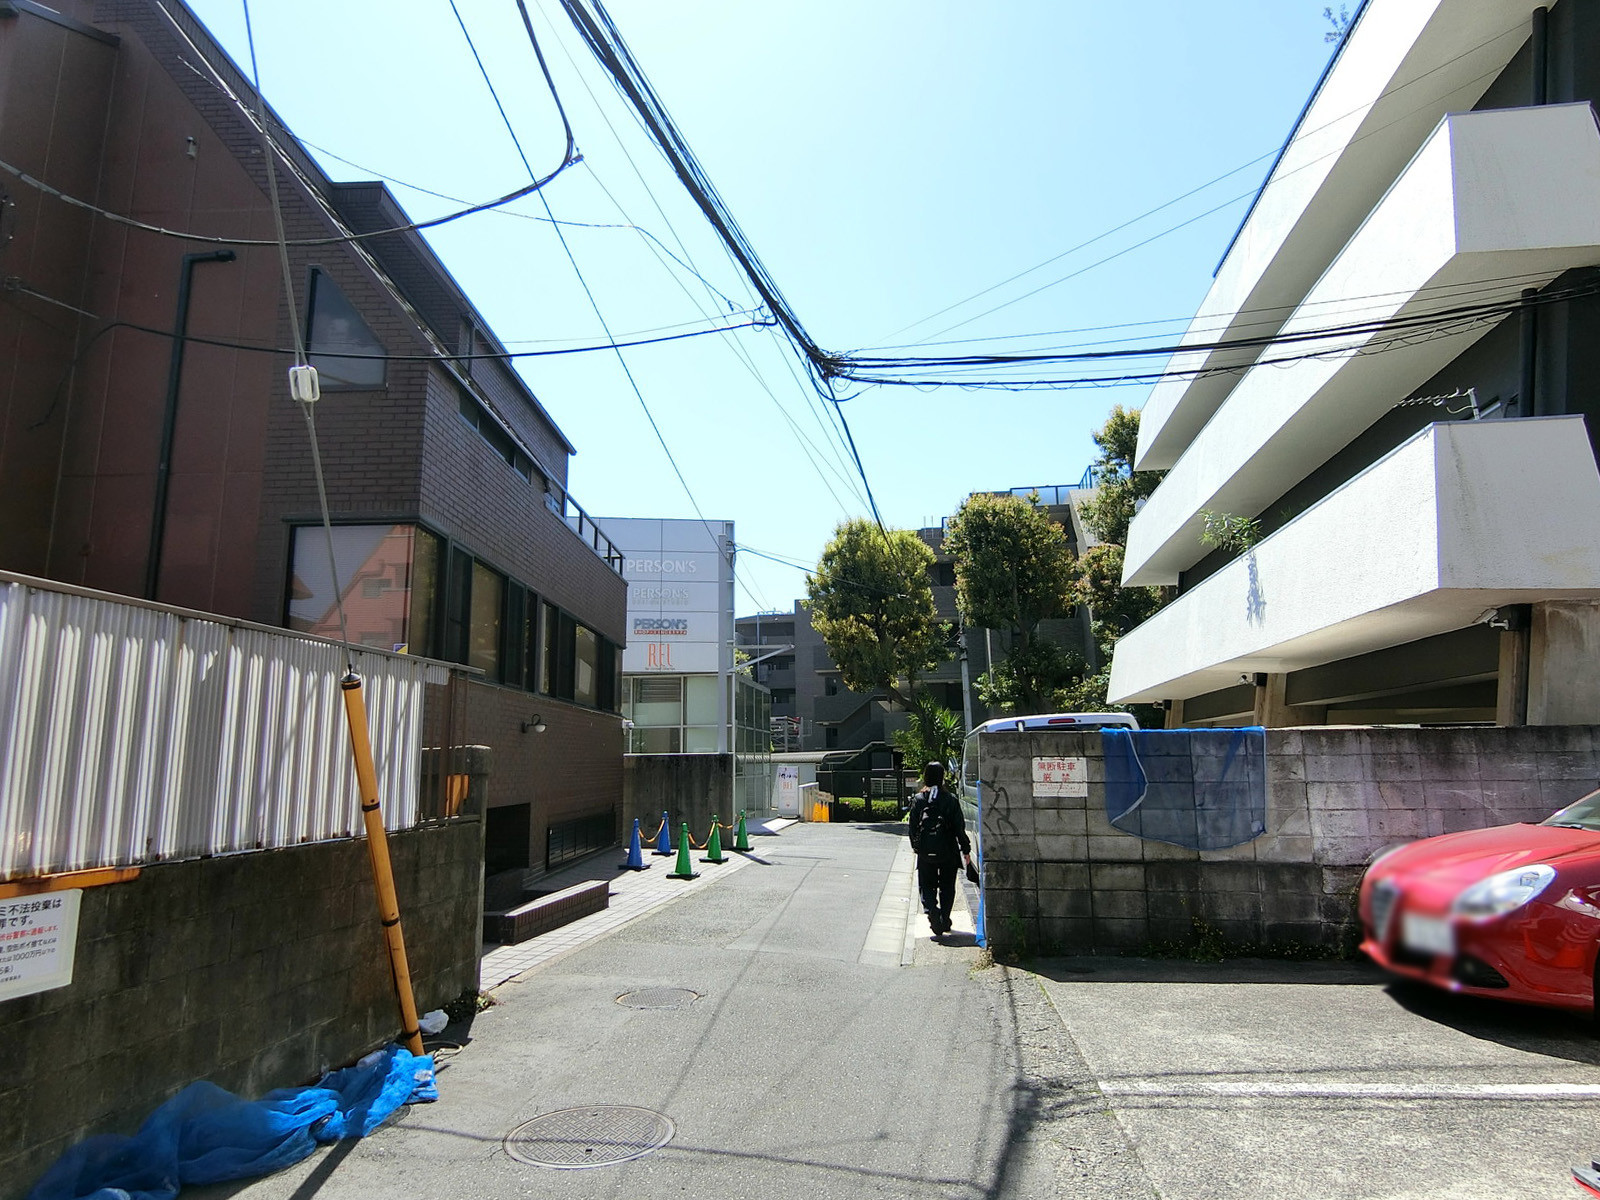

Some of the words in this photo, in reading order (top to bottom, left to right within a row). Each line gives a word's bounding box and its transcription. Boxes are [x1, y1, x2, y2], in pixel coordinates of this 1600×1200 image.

[626, 559, 697, 573] PERSON'S
[633, 587, 689, 599] PERSON'S
[633, 618, 688, 630] PERSON'S
[1037, 761, 1076, 771] 無断駐車
